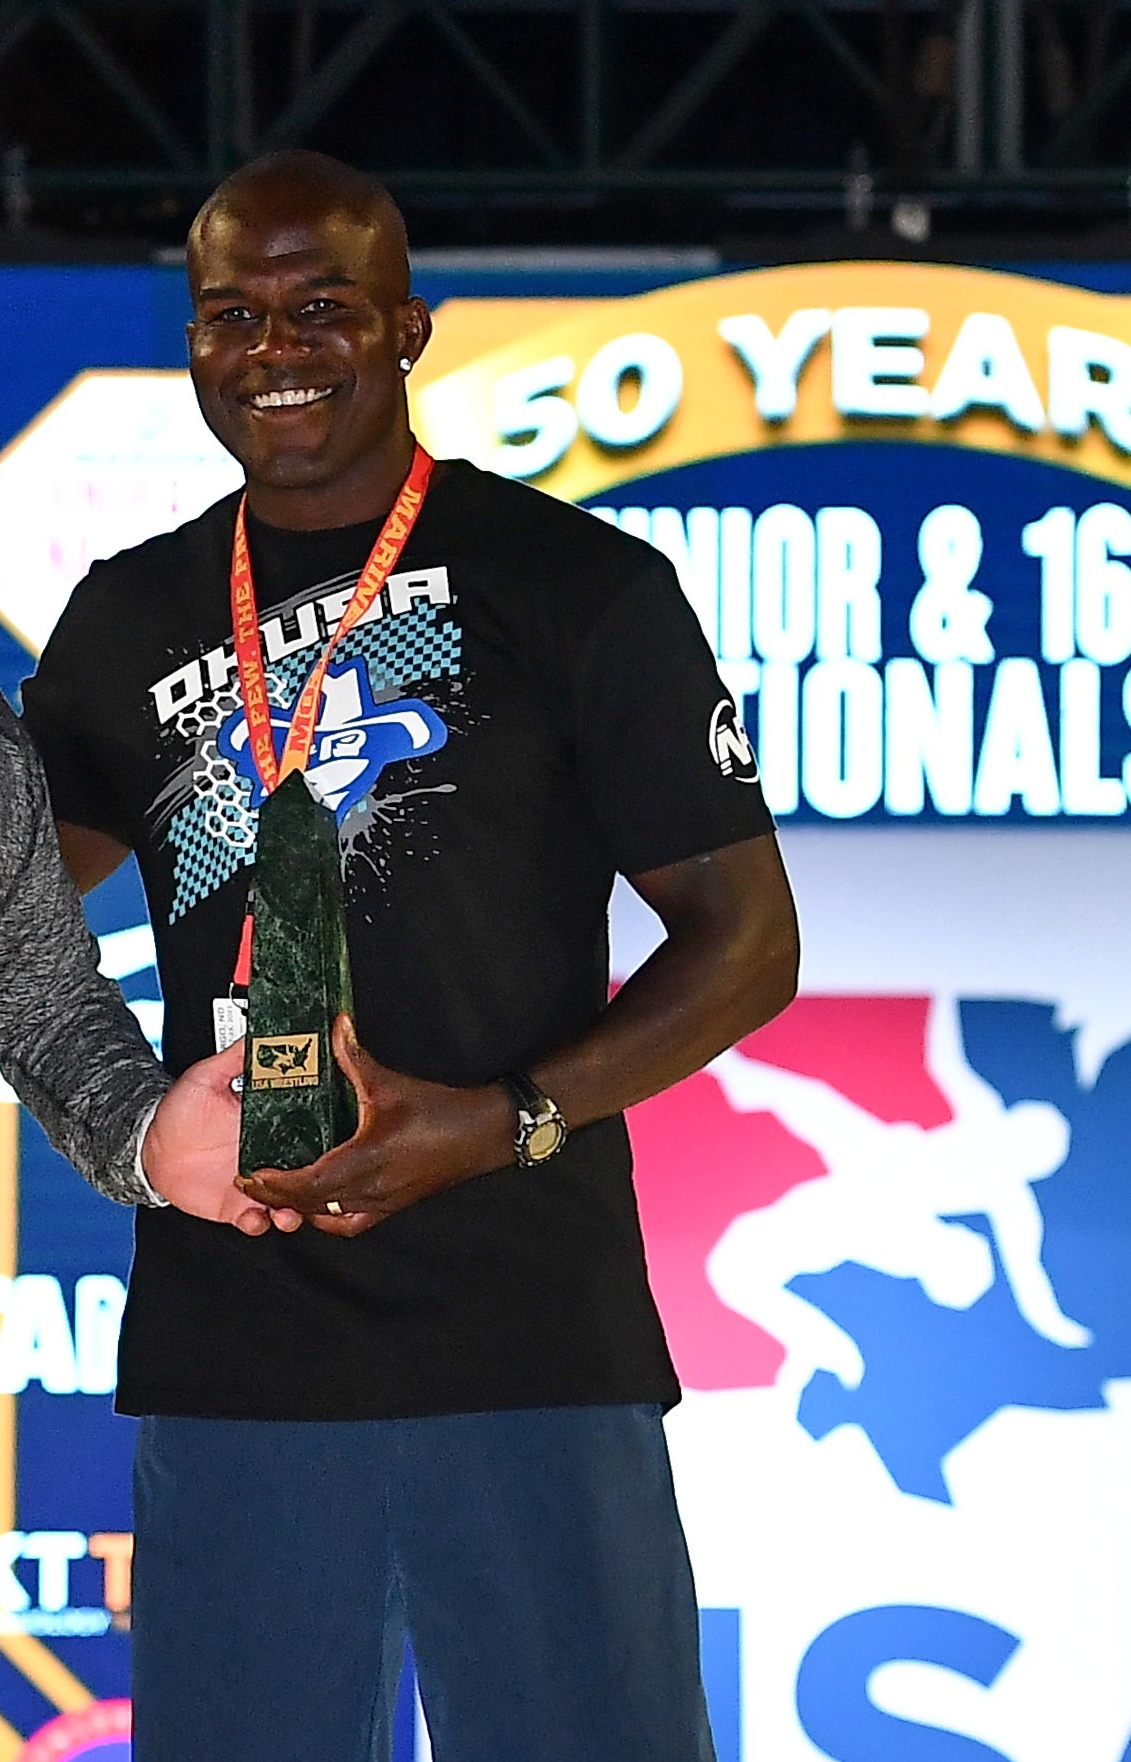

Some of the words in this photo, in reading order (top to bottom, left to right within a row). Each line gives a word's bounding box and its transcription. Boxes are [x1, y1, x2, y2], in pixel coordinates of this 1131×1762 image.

[494, 333, 683, 479] 50
[236, 581, 255, 643] THE
[582, 503, 882, 665] NIOR
[909, 504, 996, 665] &
